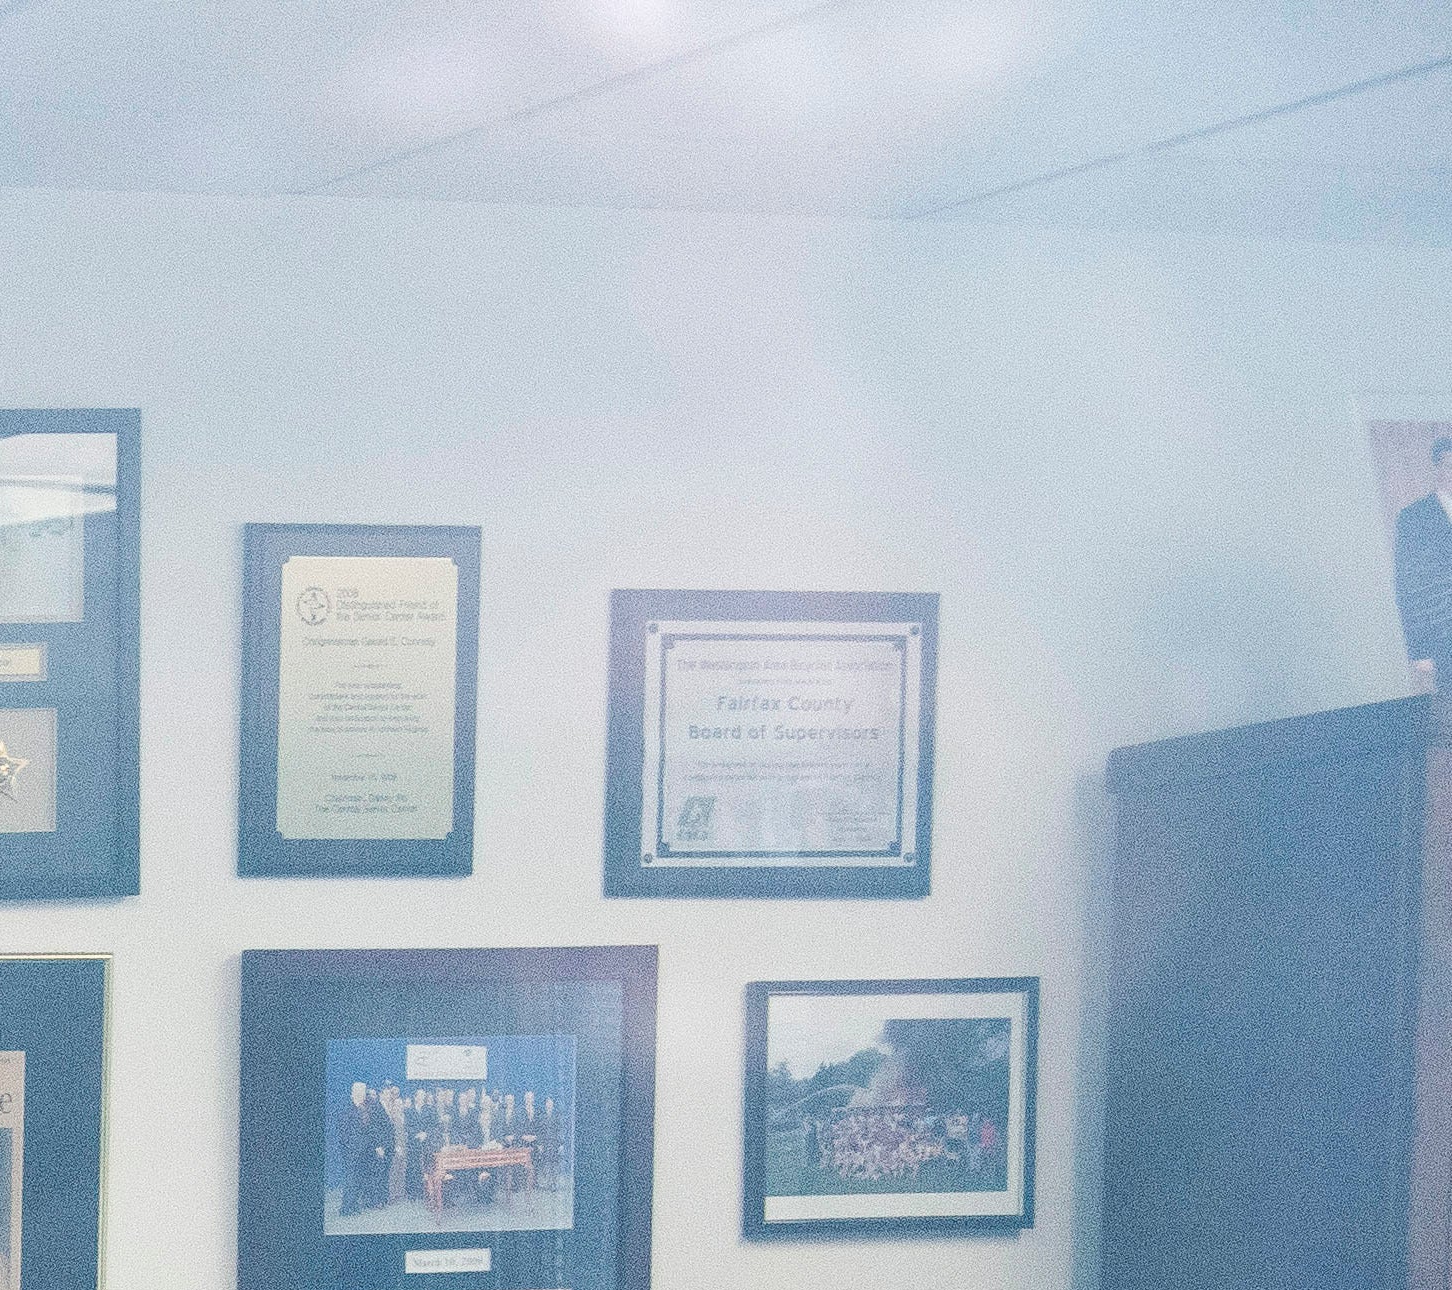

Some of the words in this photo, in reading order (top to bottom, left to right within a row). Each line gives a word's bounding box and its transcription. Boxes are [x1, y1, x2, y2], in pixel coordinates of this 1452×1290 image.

[716, 695, 781, 712] Fairfax
[787, 695, 855, 715] County
[688, 724, 742, 741] Board
[748, 724, 768, 741] of
[773, 723, 880, 744] Supervisors
[414, 1258, 441, 1268] March
